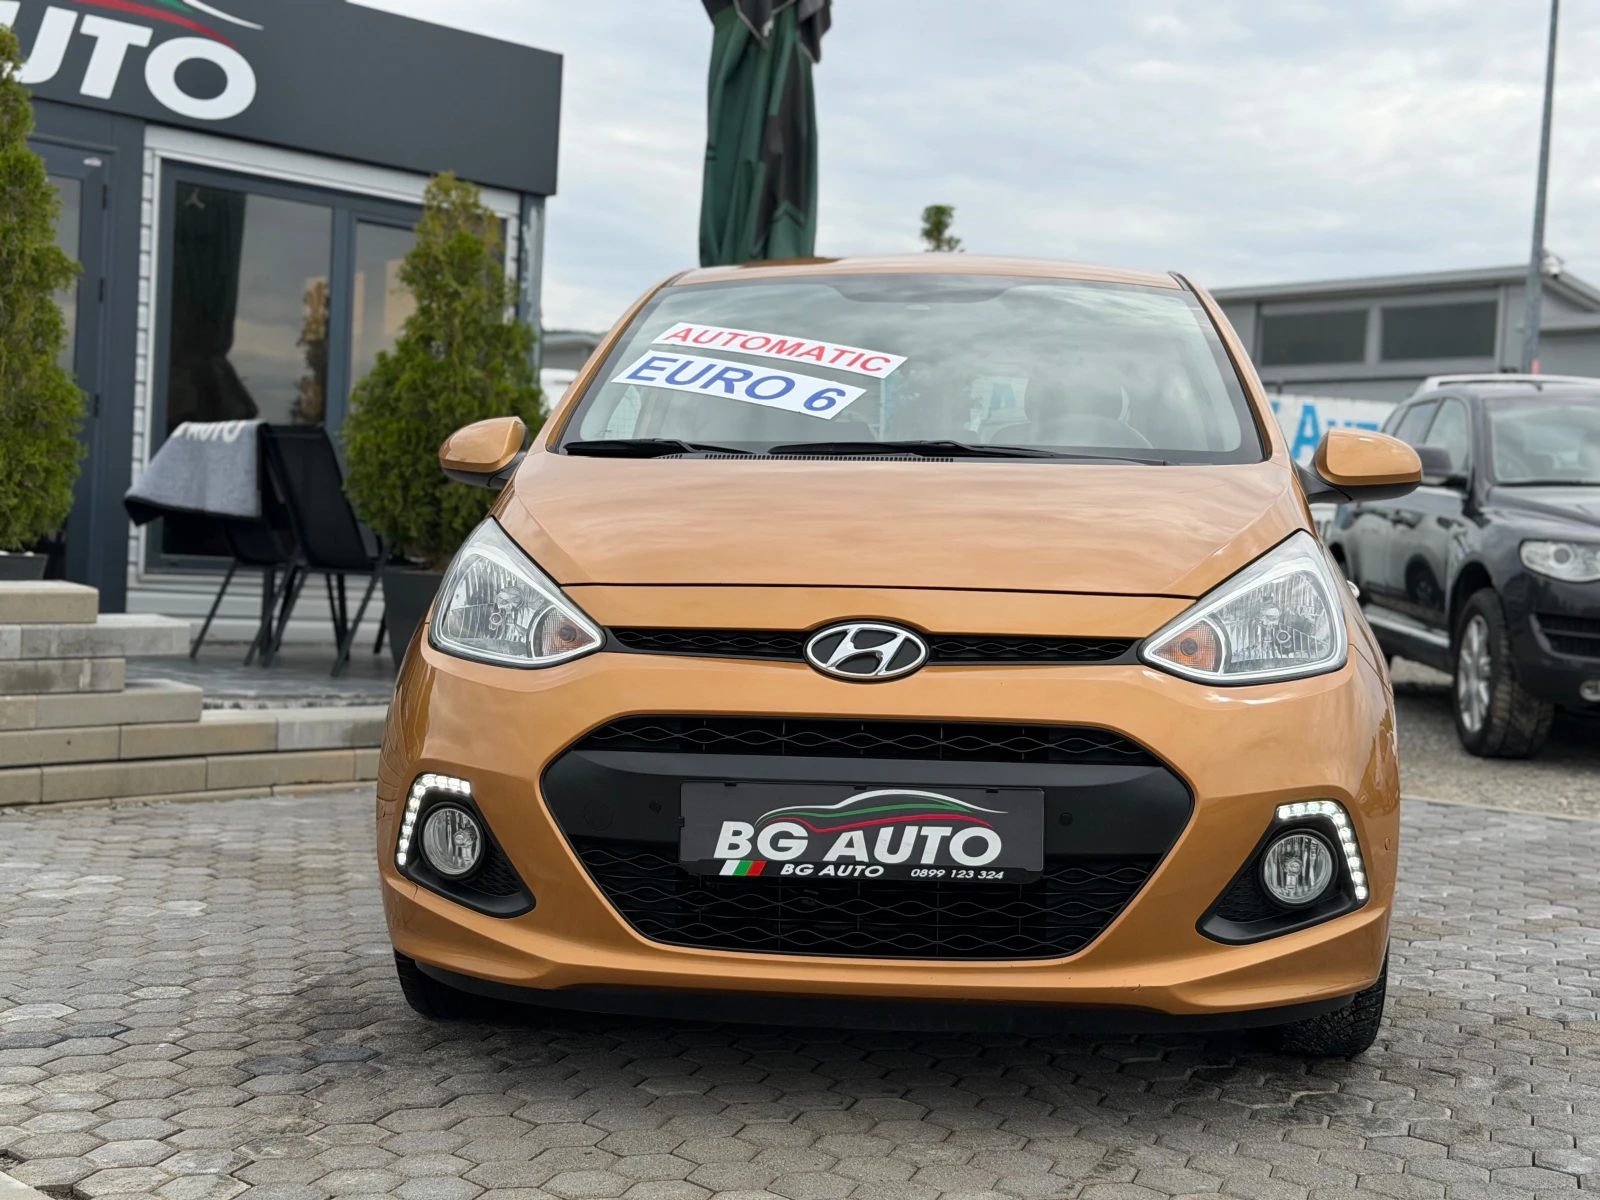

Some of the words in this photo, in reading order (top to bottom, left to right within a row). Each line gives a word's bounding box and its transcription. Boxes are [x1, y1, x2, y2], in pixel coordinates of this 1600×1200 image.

[662, 327, 892, 373] AUTOMATIC
[626, 356, 796, 400] EURO
[803, 388, 847, 412] 6
[713, 821, 809, 861] BG
[822, 825, 1002, 866] AUTO
[780, 863, 815, 876] BG
[818, 864, 885, 878] AUTO
[910, 868, 946, 878] 0899
[950, 869, 974, 879] 123
[977, 870, 1004, 880] 324
